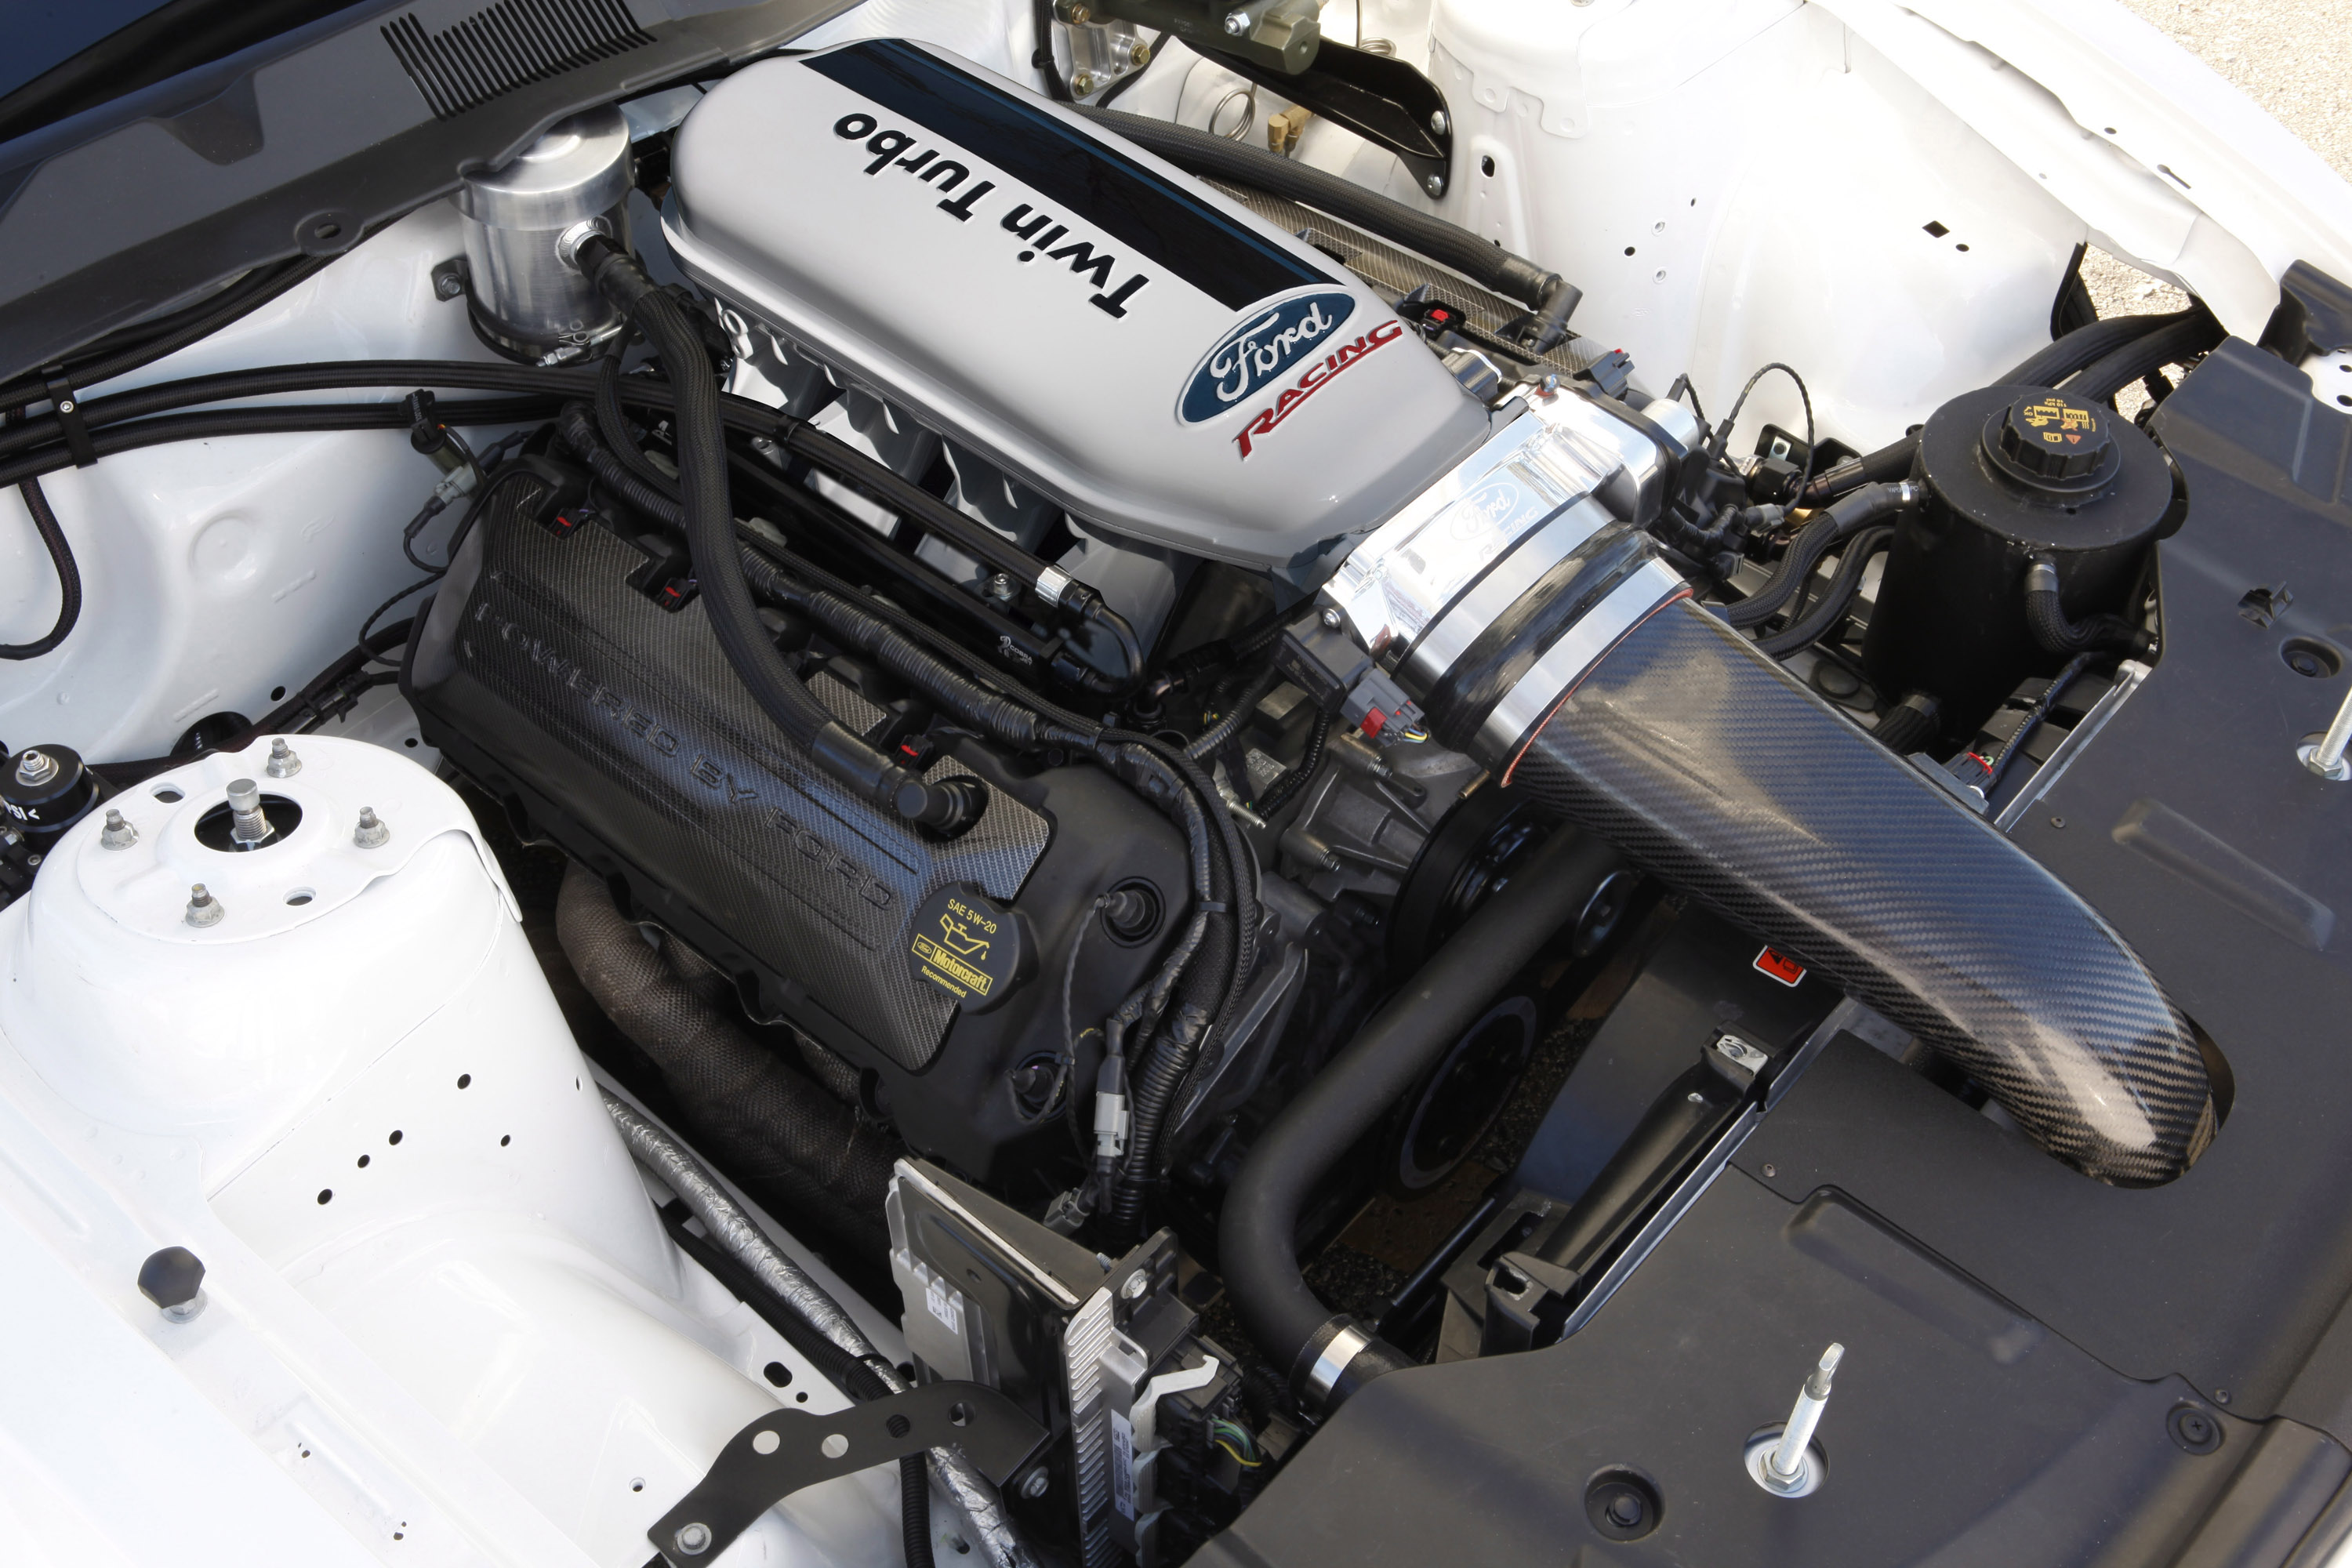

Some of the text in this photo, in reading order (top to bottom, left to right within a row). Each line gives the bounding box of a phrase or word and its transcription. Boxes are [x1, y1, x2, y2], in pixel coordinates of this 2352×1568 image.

[833, 112, 1150, 320] Twin Turbo
[1210, 302, 1333, 403] Ford
[1232, 319, 1403, 460] RACING
[474, 602, 895, 911] POWERED BY FORD
[947, 898, 997, 935] SAE 5W-20
[920, 965, 967, 998] Recommended
[933, 949, 988, 991] Motorcraft
